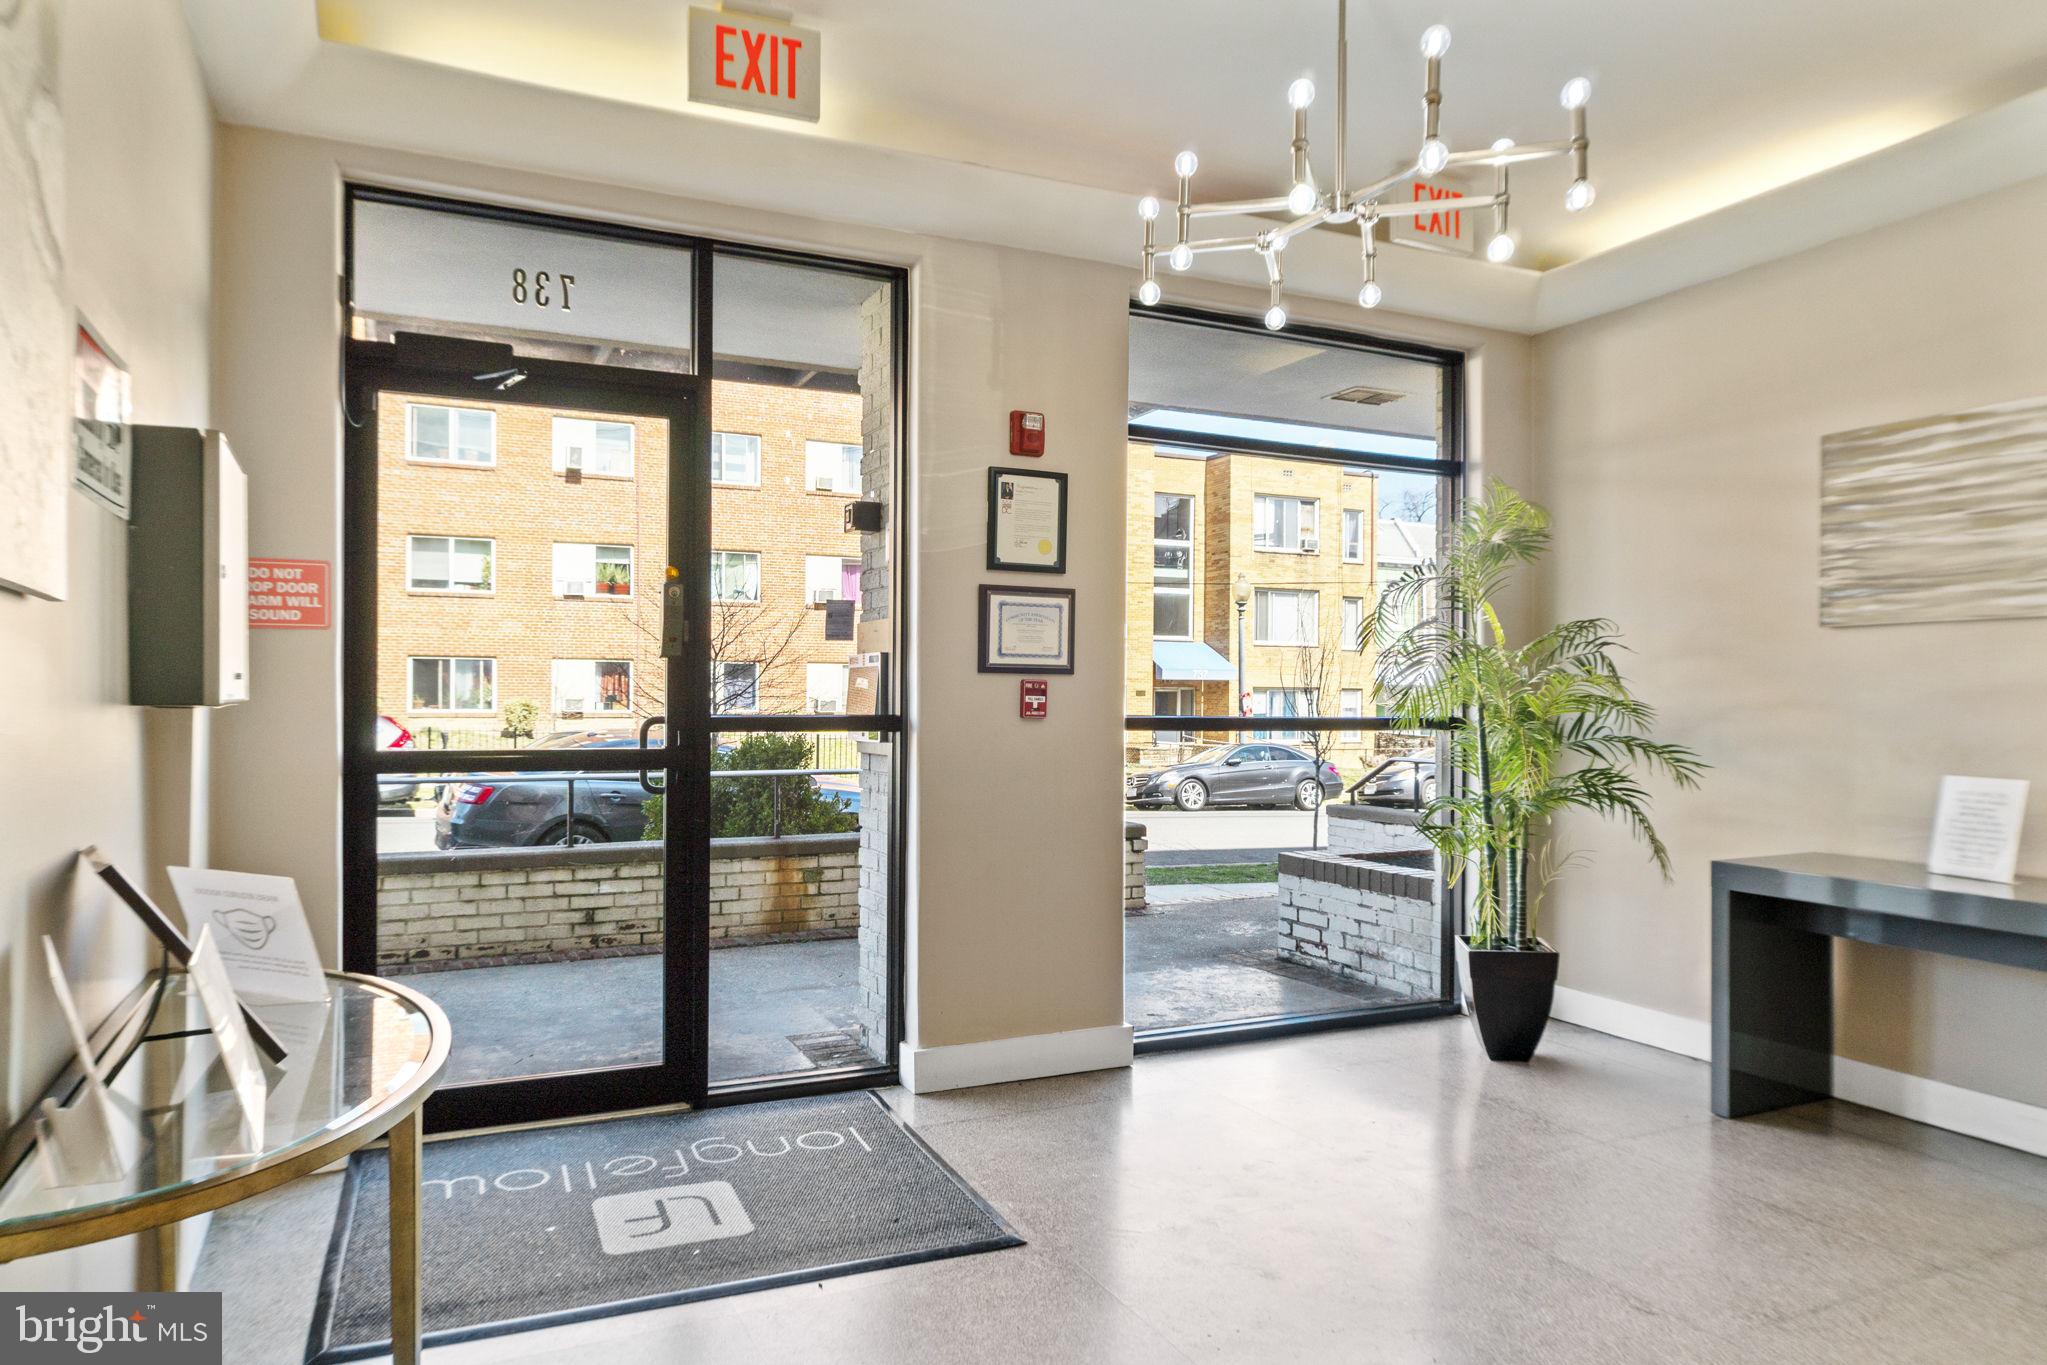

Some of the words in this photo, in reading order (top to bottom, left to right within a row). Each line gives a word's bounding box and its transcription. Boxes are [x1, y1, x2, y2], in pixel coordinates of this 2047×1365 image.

[715, 23, 802, 100] EXIT
[1413, 182, 1464, 240] EXIT
[248, 567, 270, 578] DO
[273, 568, 304, 580] NOT
[248, 581, 274, 593] OP
[275, 581, 320, 594] DOOR
[248, 595, 283, 607] ARM
[285, 596, 323, 608] WILL
[249, 609, 303, 621] SOUND
[420, 1126, 872, 1200] longfellow
